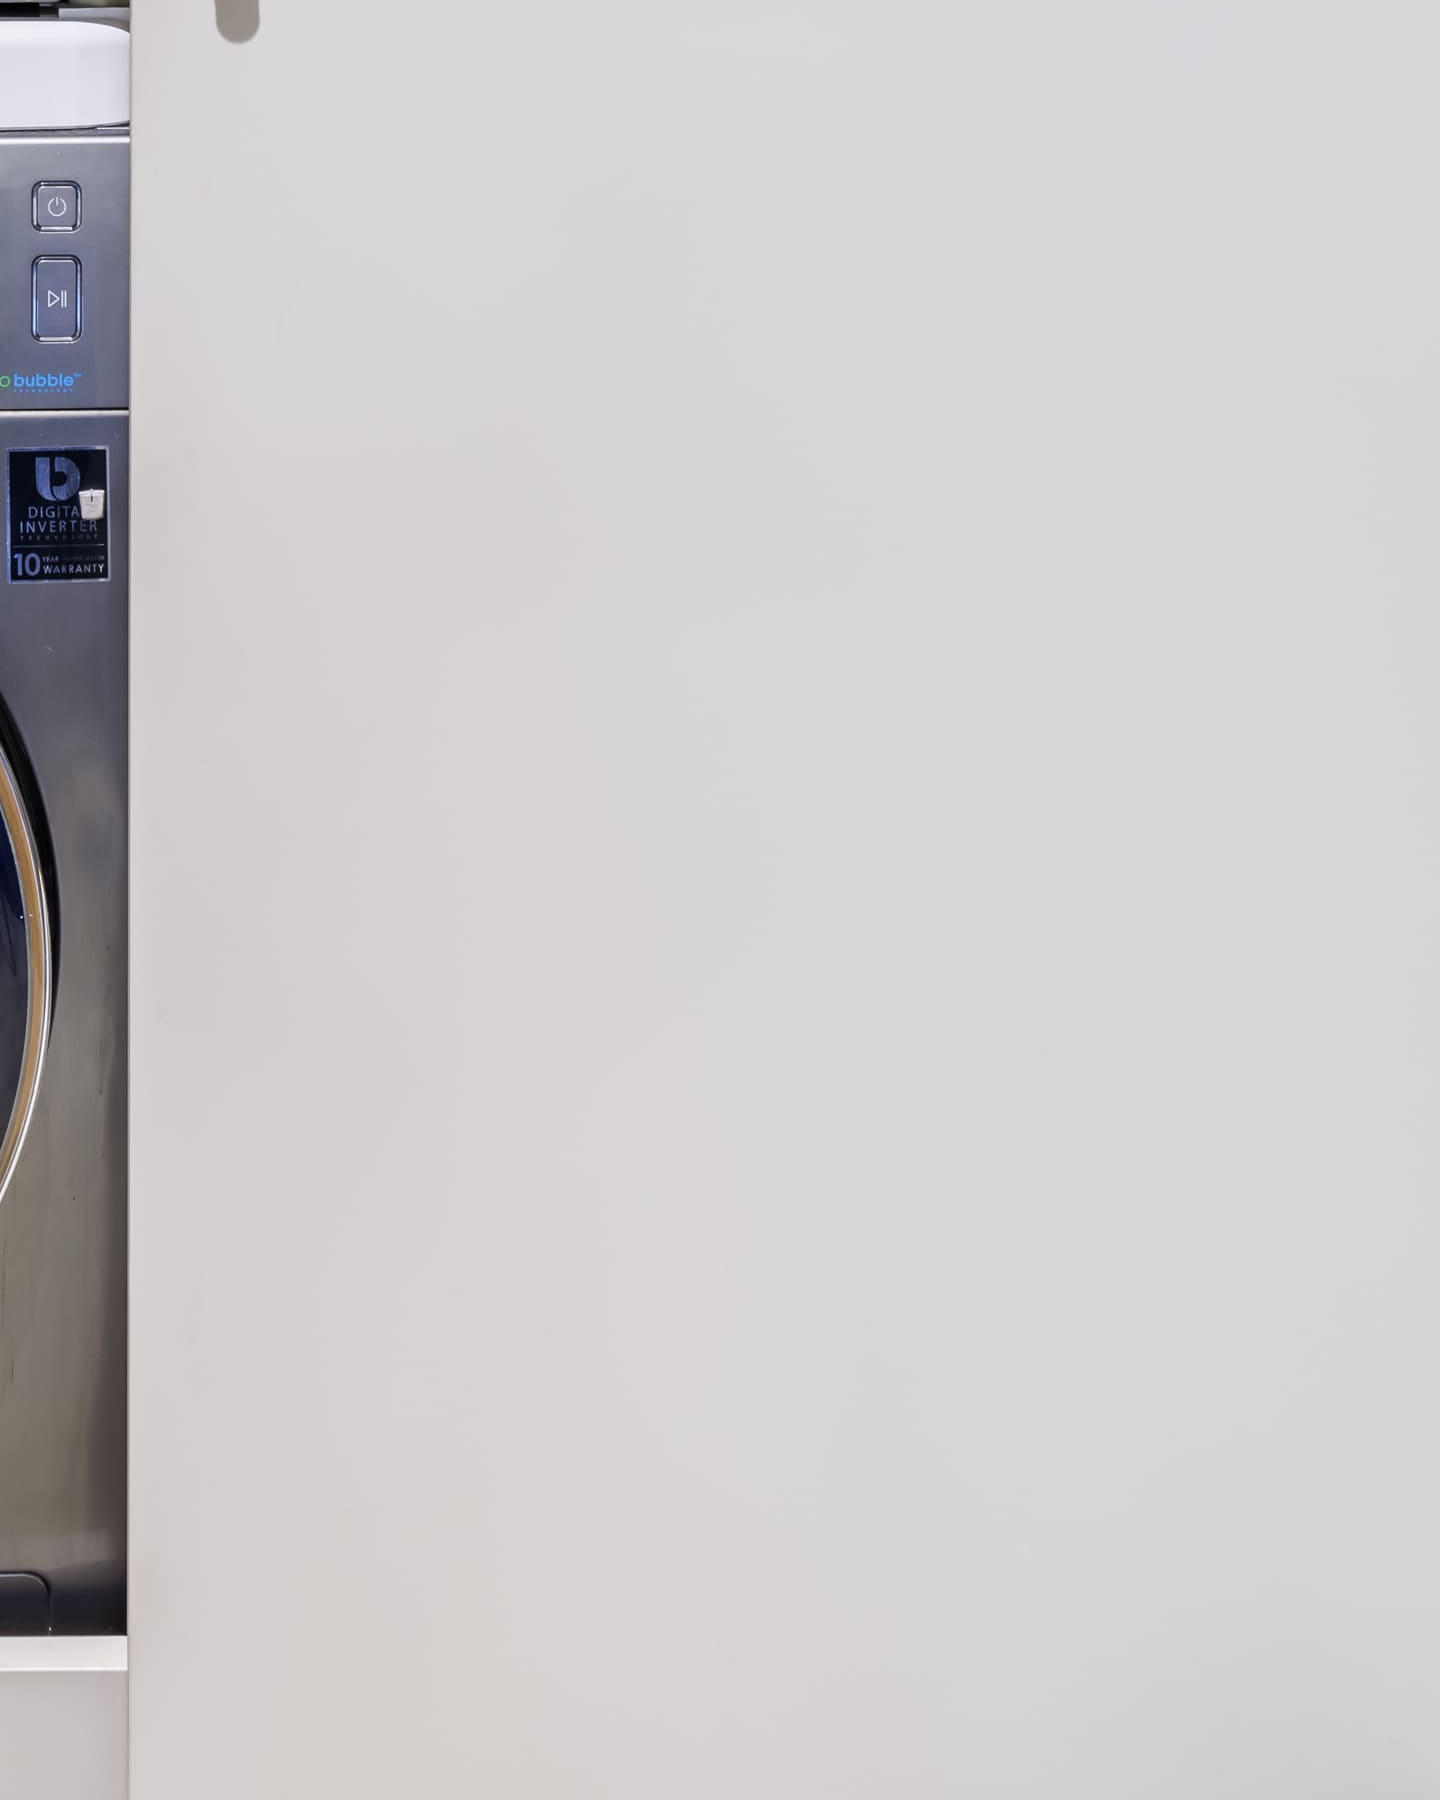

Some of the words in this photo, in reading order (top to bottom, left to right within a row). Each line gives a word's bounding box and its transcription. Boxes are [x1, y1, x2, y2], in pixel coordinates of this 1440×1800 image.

[28, 506, 80, 519] DIGITA
[20, 520, 97, 534] INVERTER
[14, 552, 40, 576] 10
[43, 564, 104, 574] WARRANTY
